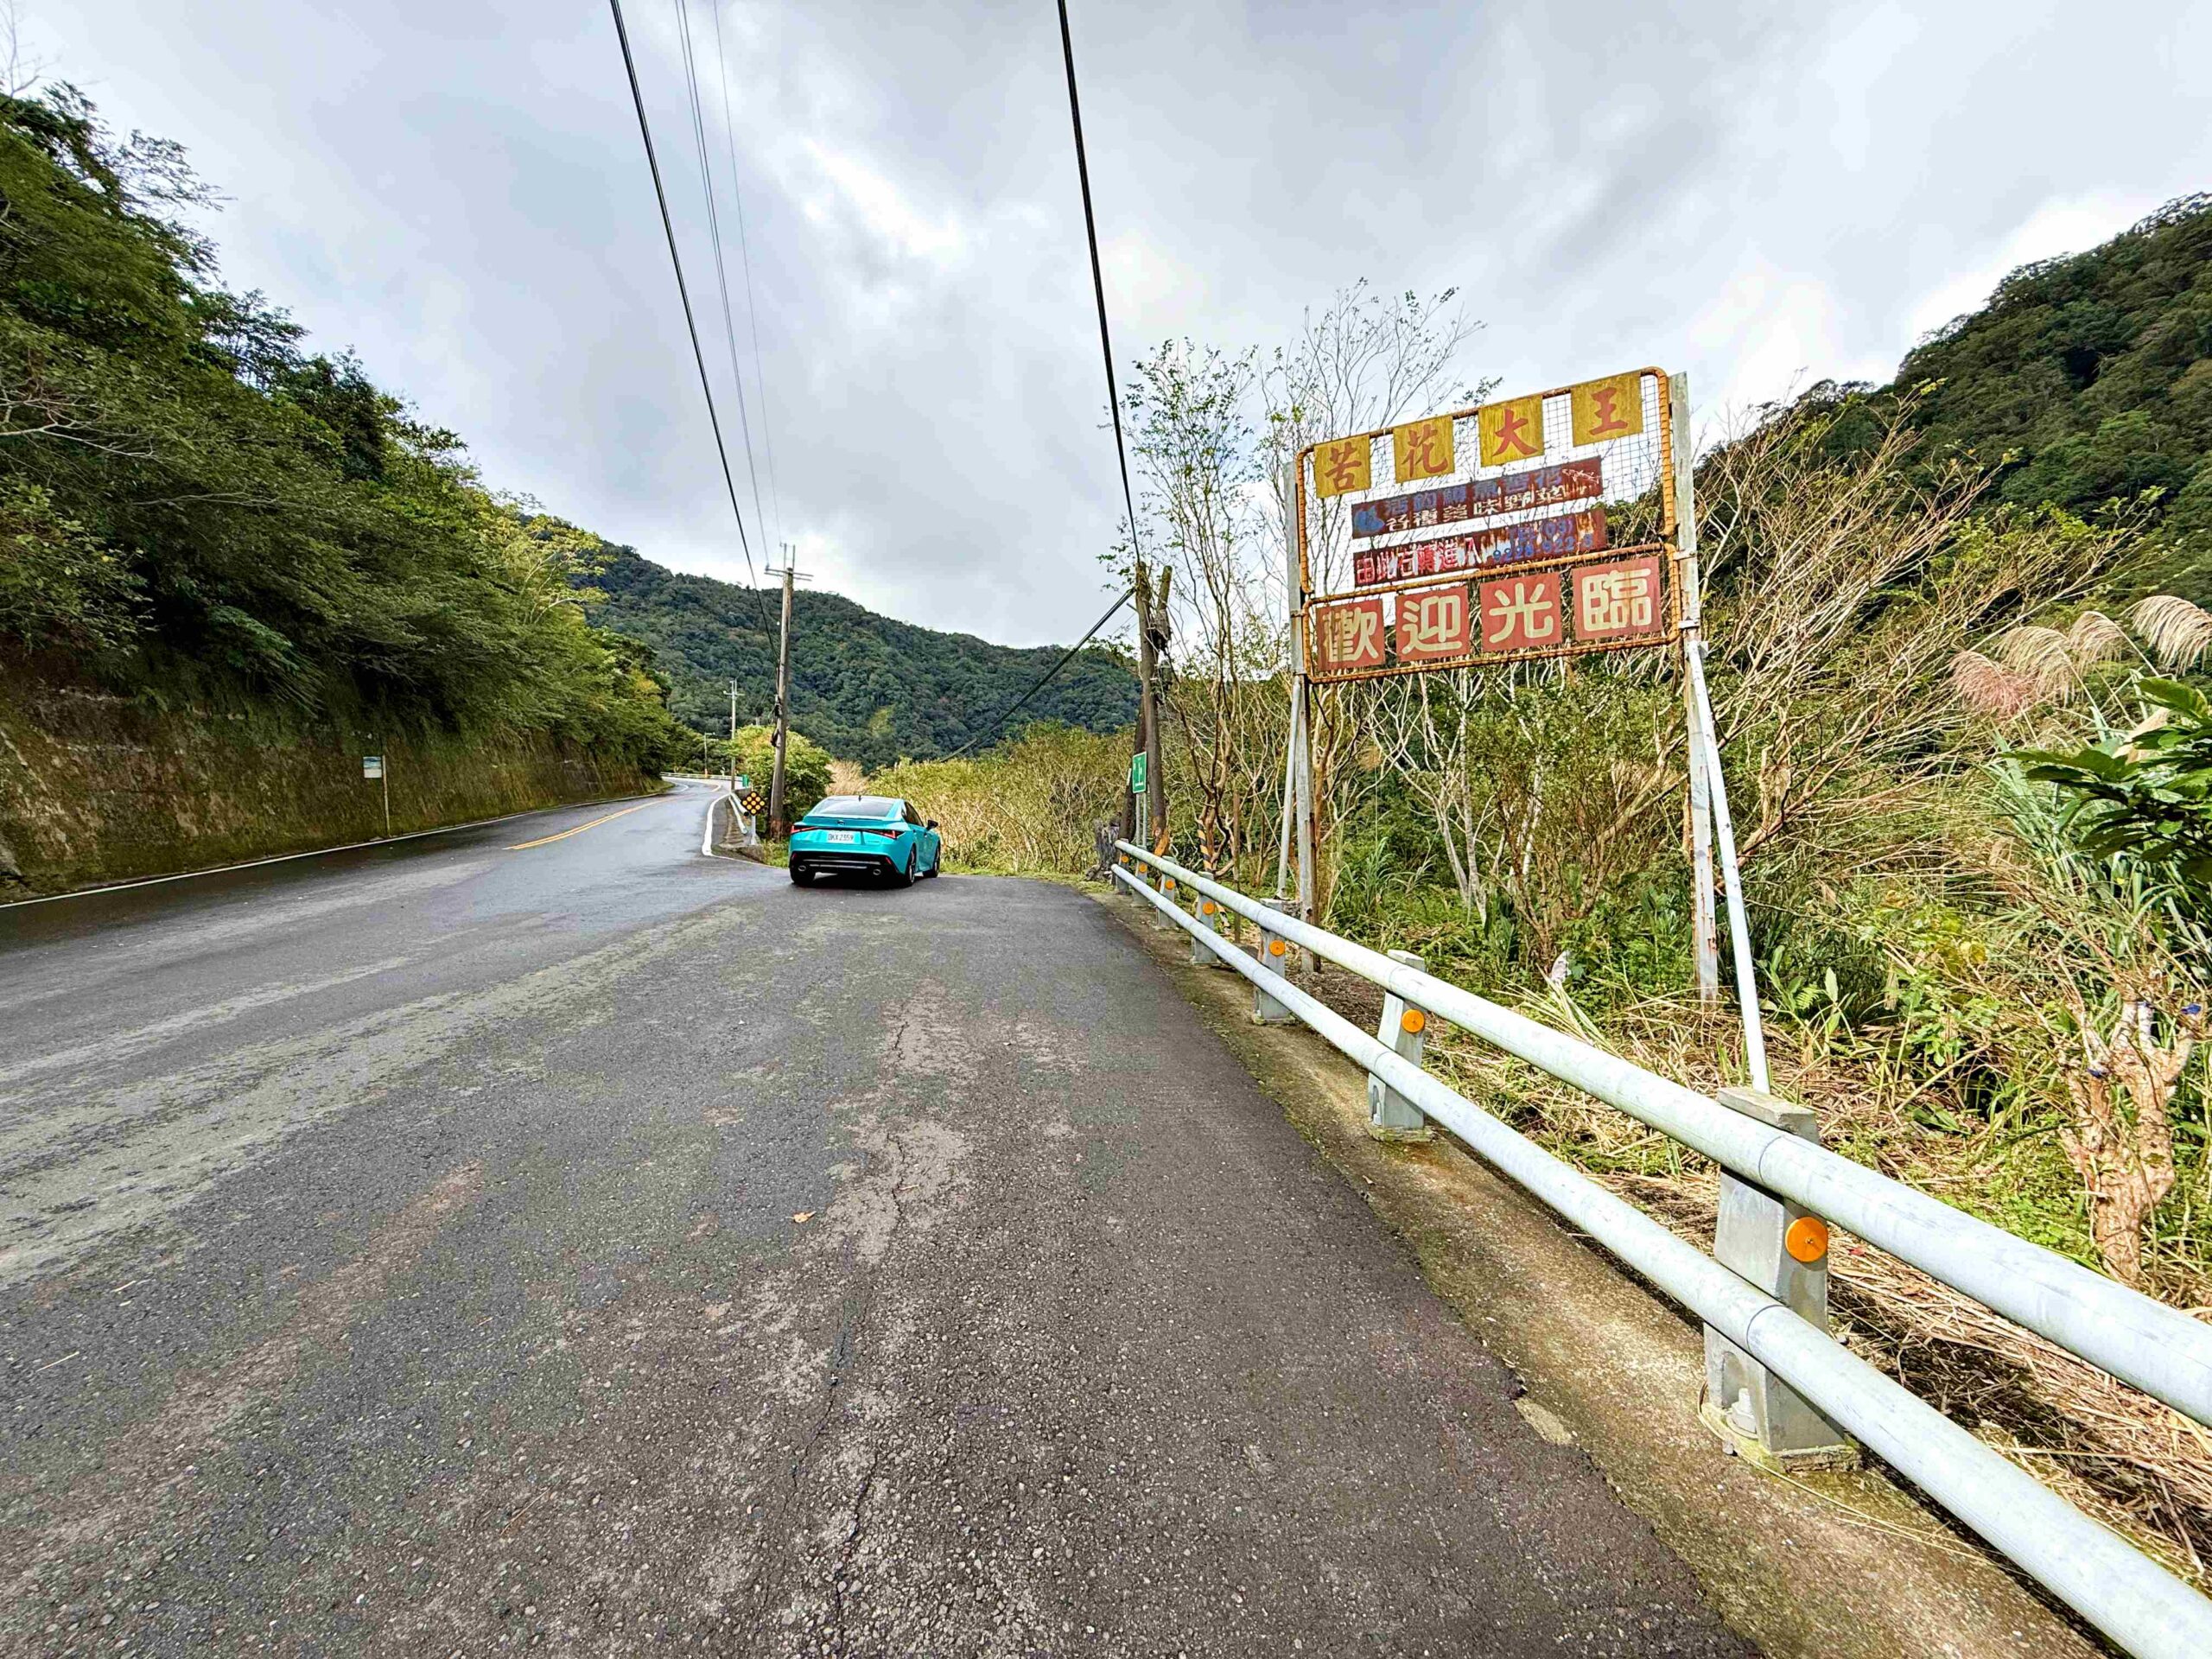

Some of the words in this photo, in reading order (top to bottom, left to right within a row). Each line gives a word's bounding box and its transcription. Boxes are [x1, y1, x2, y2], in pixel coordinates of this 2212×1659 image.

[1325, 386, 1629, 494] 苦花大王
[1323, 567, 1651, 663] 歡迎光臨
